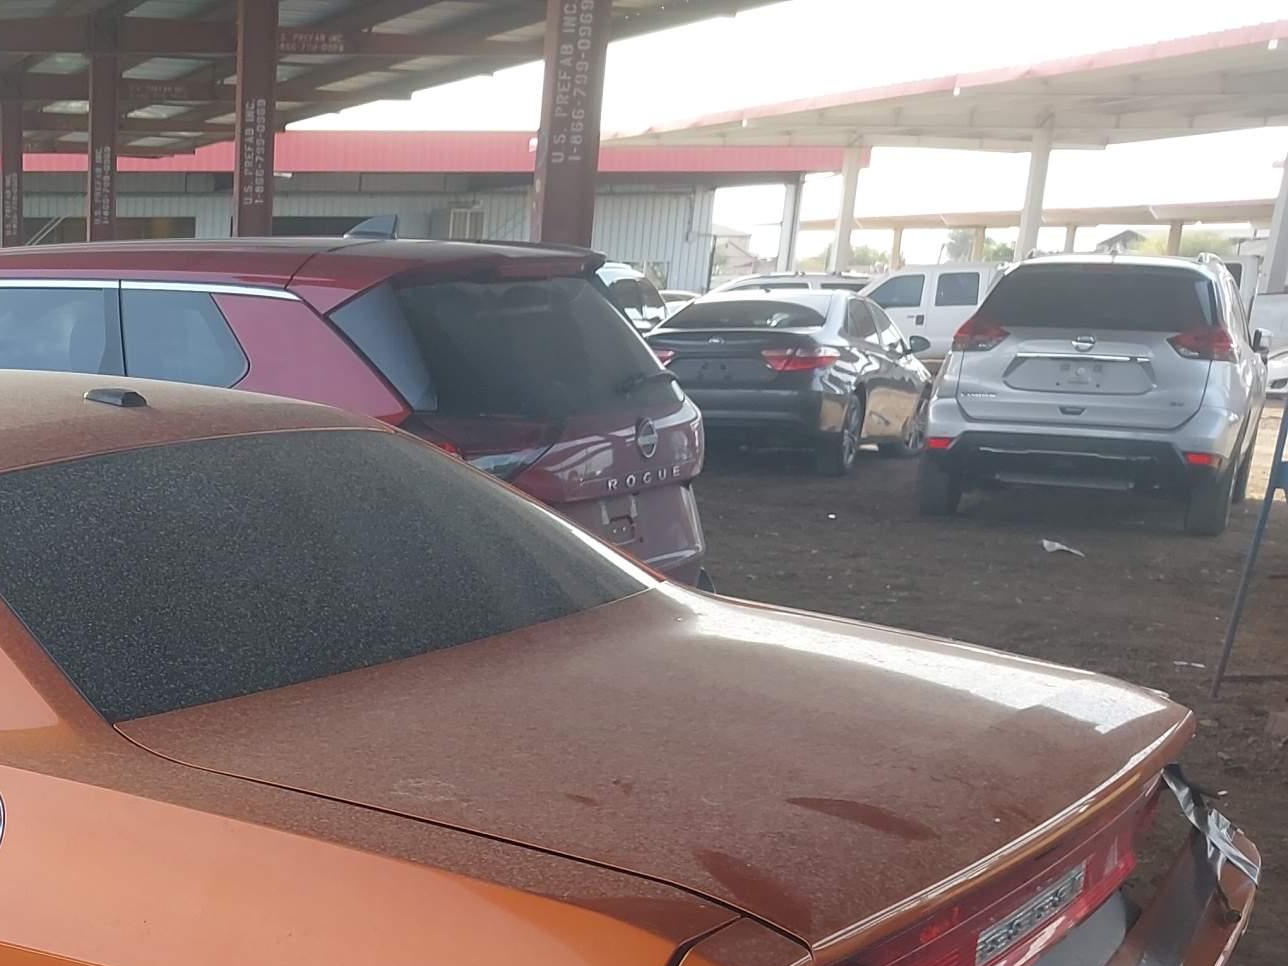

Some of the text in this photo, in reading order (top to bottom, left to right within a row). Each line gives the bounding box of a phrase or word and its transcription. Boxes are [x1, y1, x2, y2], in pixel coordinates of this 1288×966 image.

[552, 43, 574, 118] PREFAB
[244, 128, 254, 175] PREFAB
[551, 127, 569, 164] U.S.
[244, 182, 253, 205] U.S.
[607, 466, 680, 491] ROGUE
